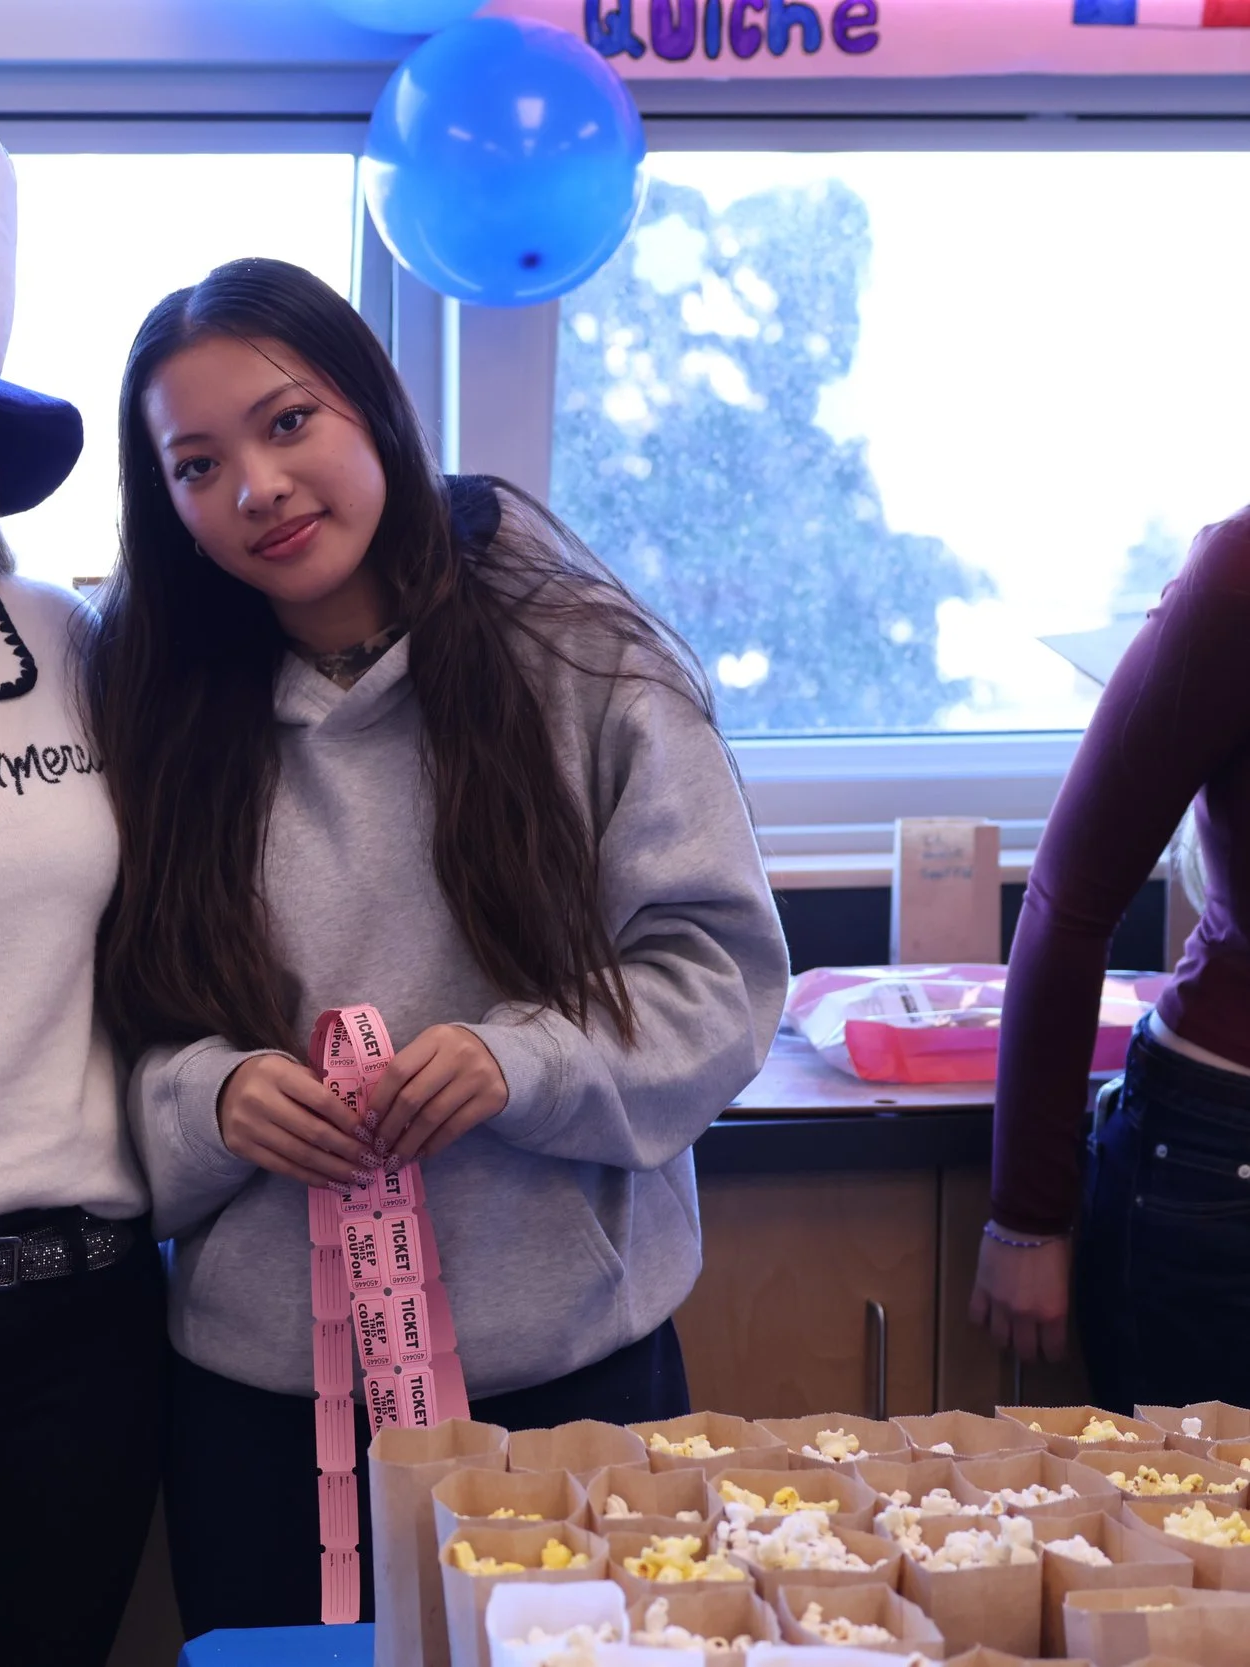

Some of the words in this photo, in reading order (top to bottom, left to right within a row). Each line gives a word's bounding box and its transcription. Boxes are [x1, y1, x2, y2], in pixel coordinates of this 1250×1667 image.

[354, 1012, 381, 1058] TICKET
[329, 1059, 355, 1067] 450449
[364, 1061, 389, 1072] 450449
[344, 1203, 368, 1212] 450447
[383, 1199, 407, 1207] 450447
[347, 1226, 362, 1279] COUPON
[358, 1241, 367, 1261] THIS
[364, 1234, 376, 1267] KEEP
[391, 1220, 410, 1271] TICKET
[354, 1280, 378, 1288] 450446
[393, 1275, 417, 1284] 450446
[358, 1303, 373, 1356] COUPON
[369, 1318, 377, 1338] THIS
[375, 1312, 387, 1344] KEEP
[401, 1298, 419, 1349] TICKET
[380, 1395, 388, 1416] THIS
[385, 1389, 397, 1422] KEEP
[410, 1375, 427, 1427] TICKET
